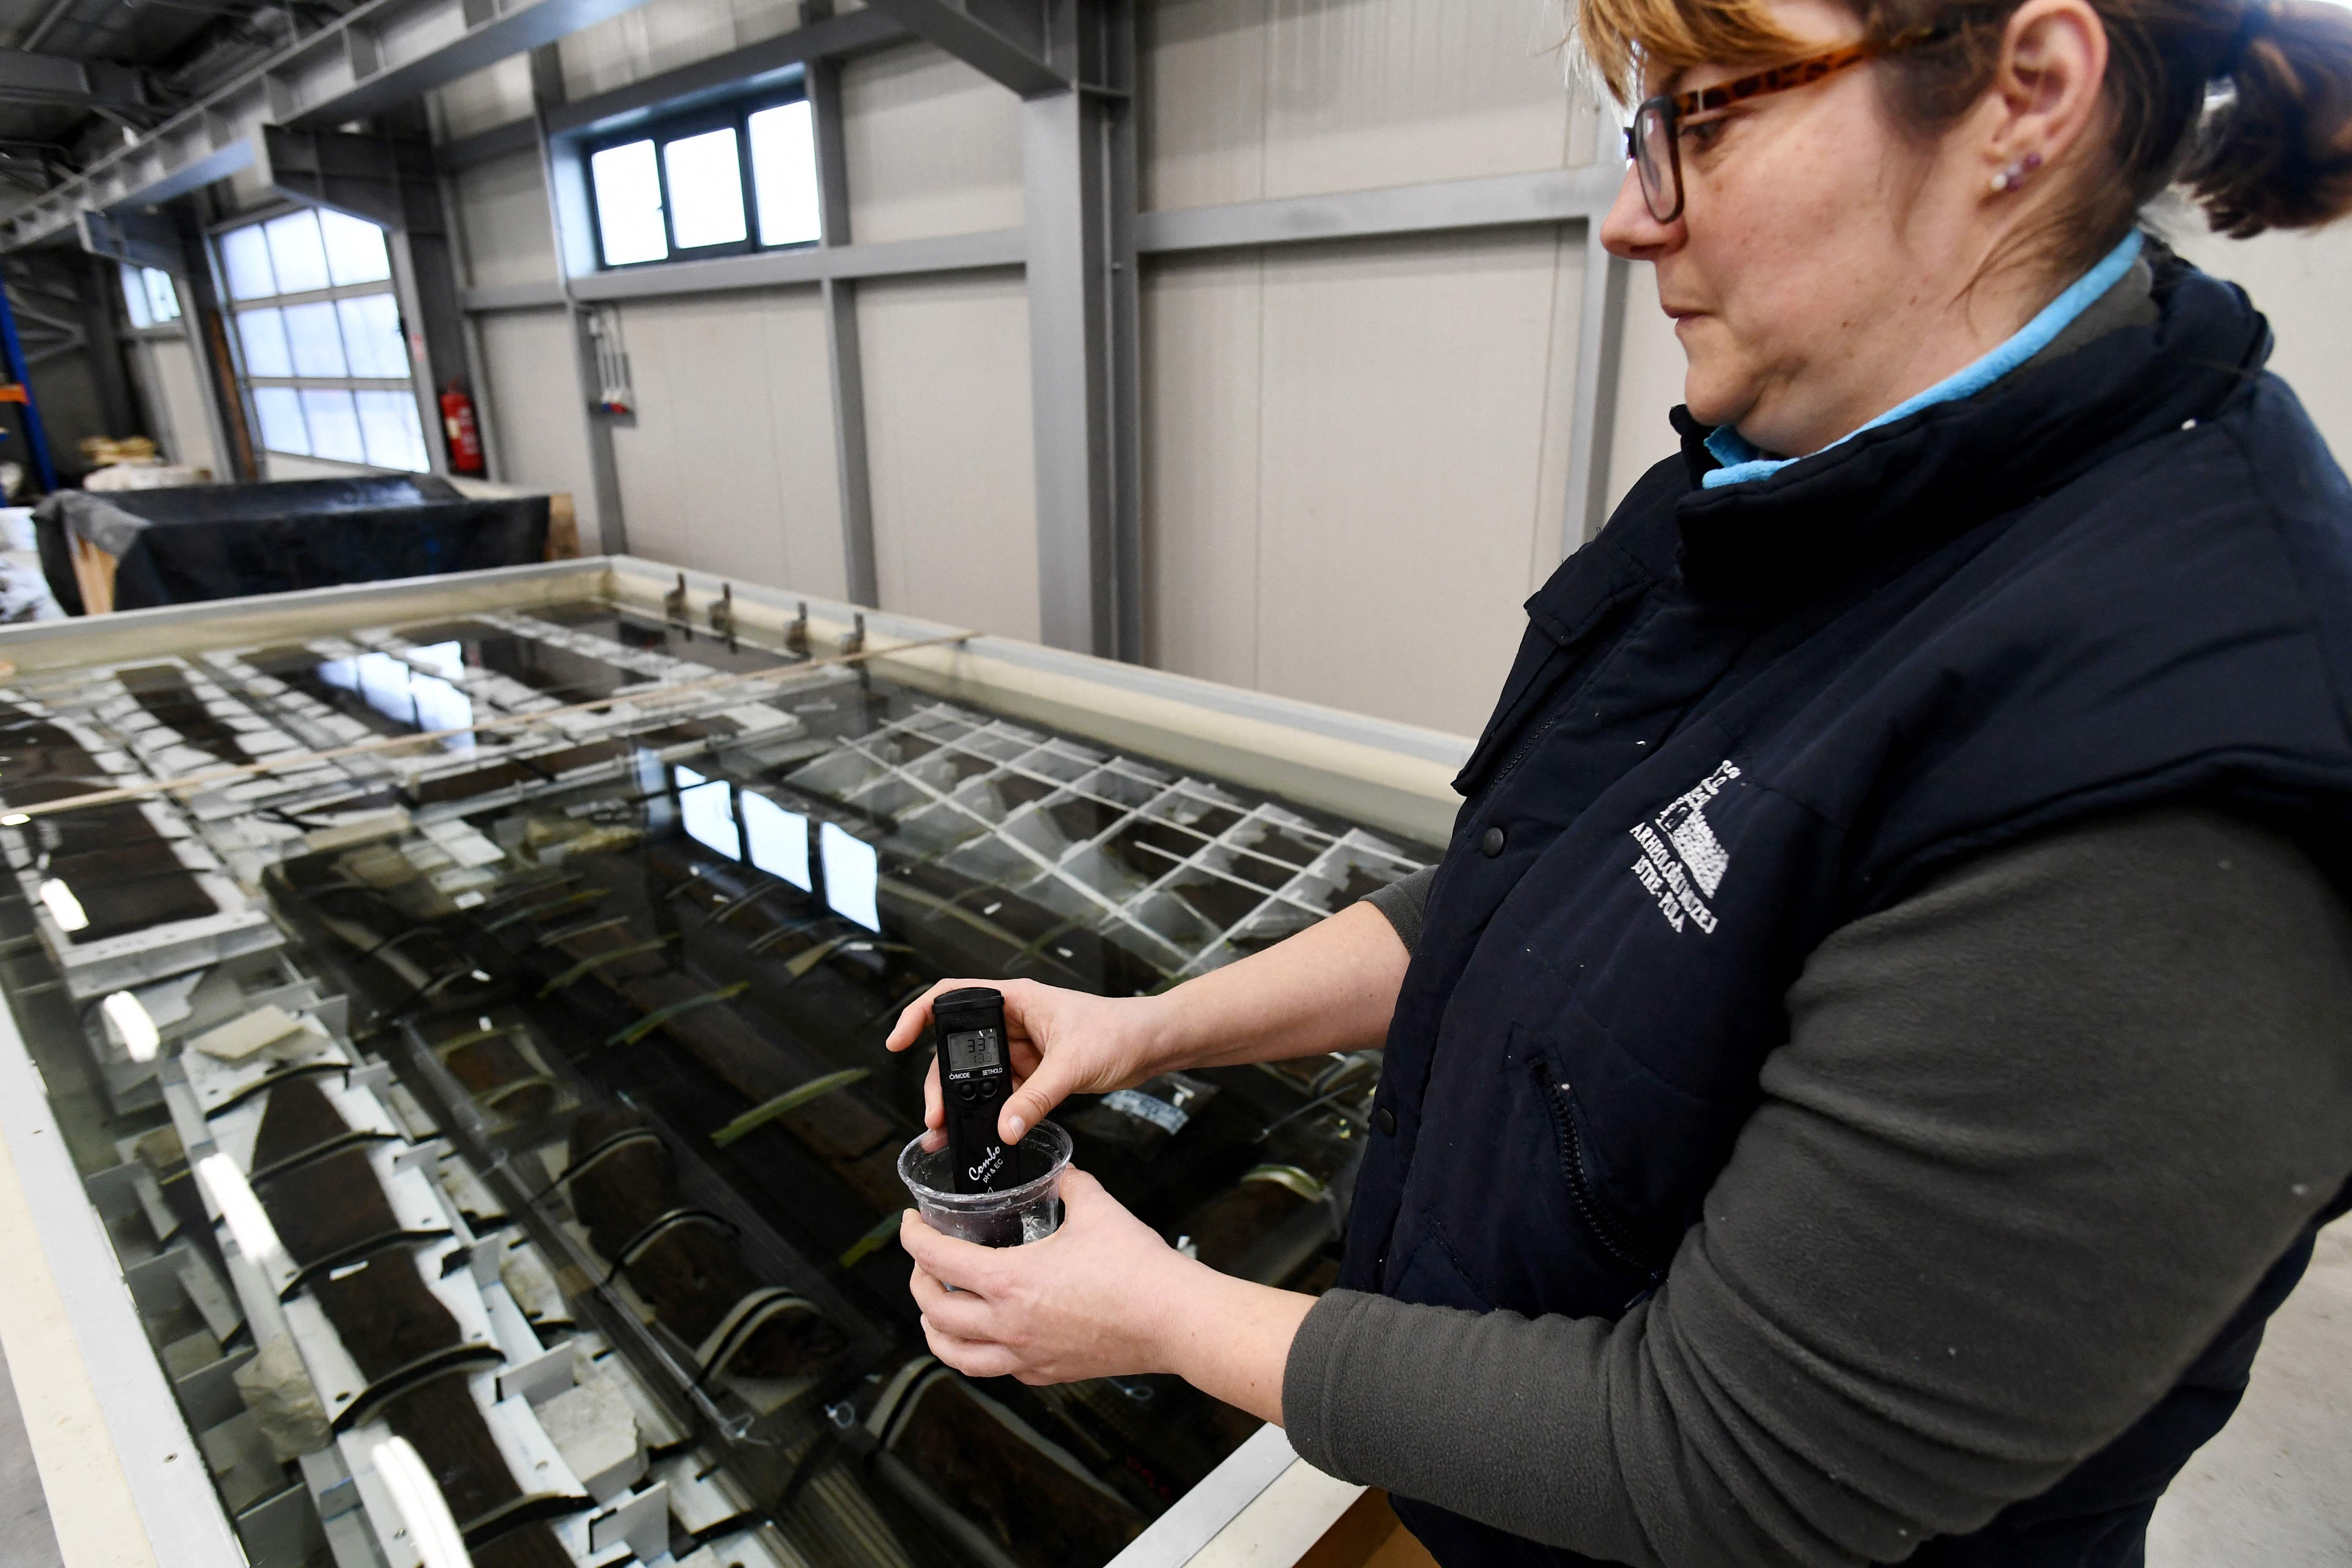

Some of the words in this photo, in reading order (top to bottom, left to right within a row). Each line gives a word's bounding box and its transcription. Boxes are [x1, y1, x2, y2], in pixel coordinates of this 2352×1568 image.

[983, 1067, 1002, 1075] SET/HOLD
[969, 1146, 1000, 1181] Combo
[983, 1172, 991, 1183] pH
[994, 1159, 1003, 1169] EC
